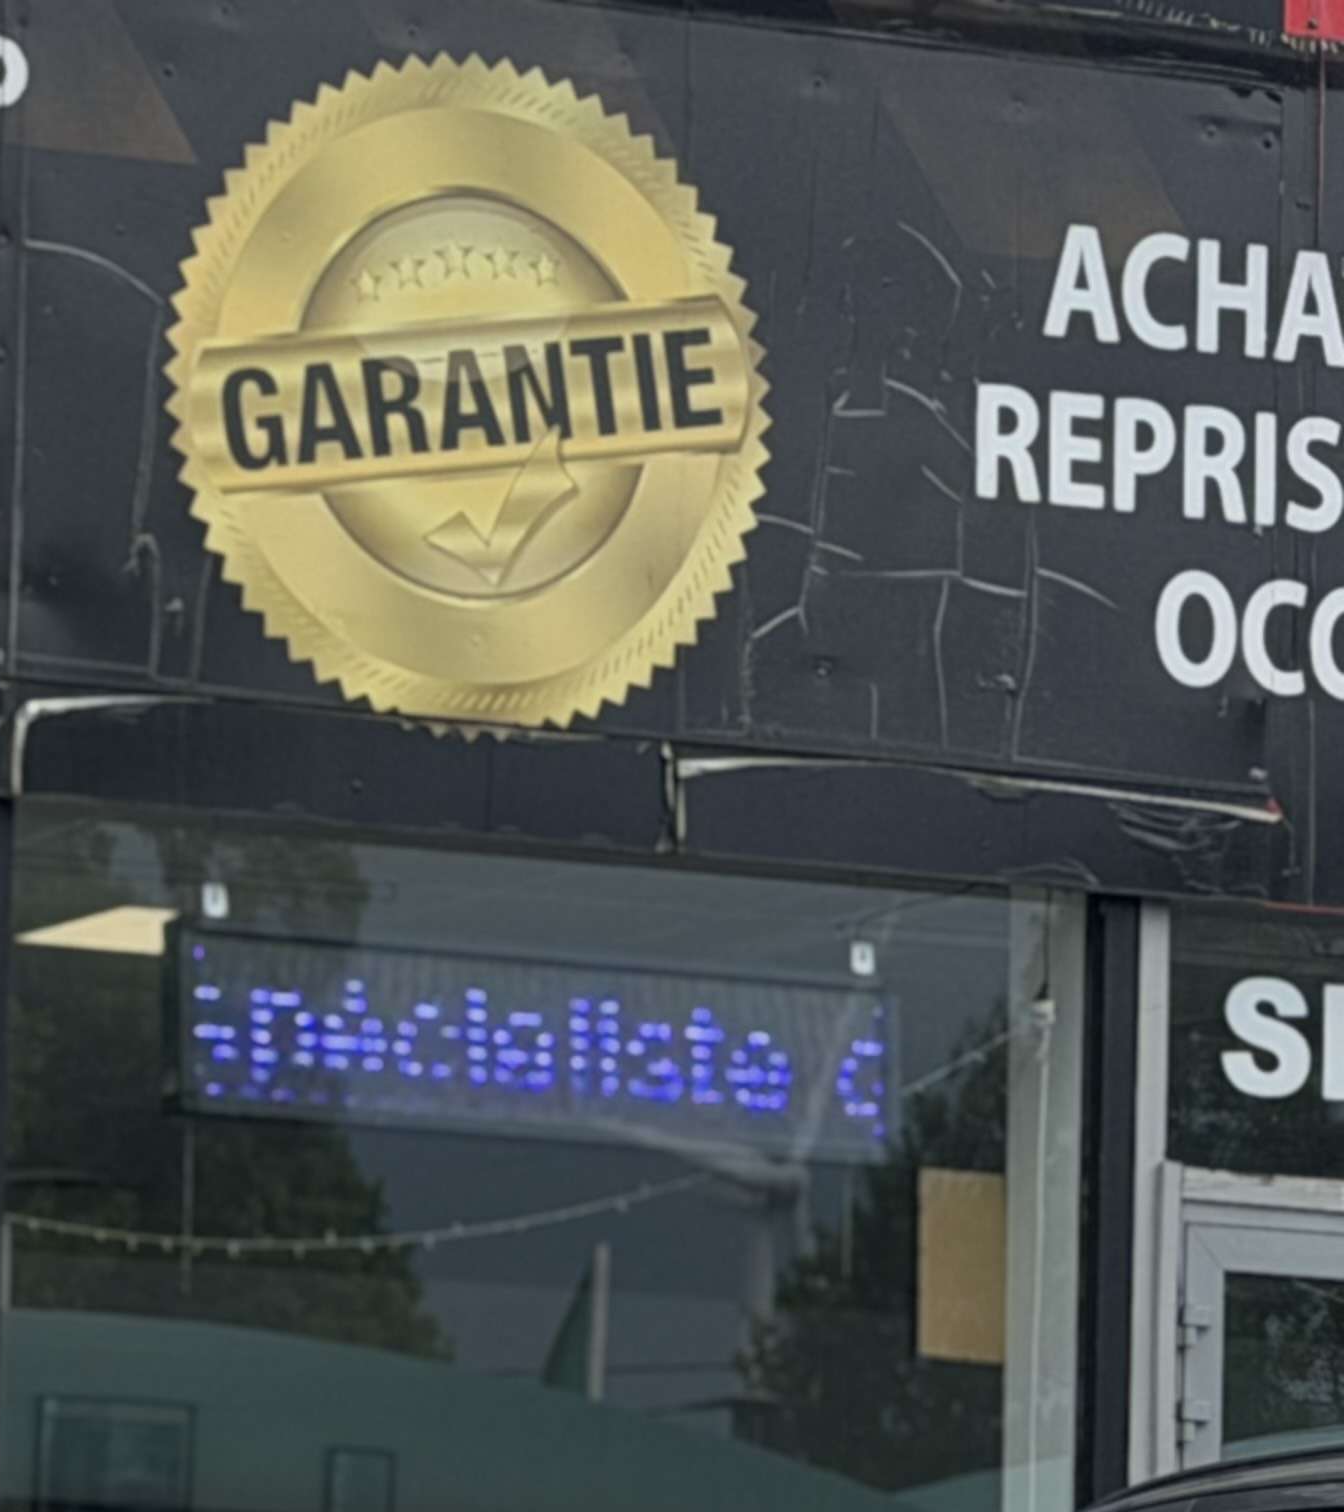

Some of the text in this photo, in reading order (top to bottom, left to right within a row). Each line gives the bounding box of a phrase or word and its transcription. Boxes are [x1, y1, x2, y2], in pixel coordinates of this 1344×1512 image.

[1042, 222, 1344, 369] ACHA
[220, 324, 725, 475] GARANTIE
[974, 380, 1344, 534] REPRIS
[1220, 975, 1344, 1102] S
